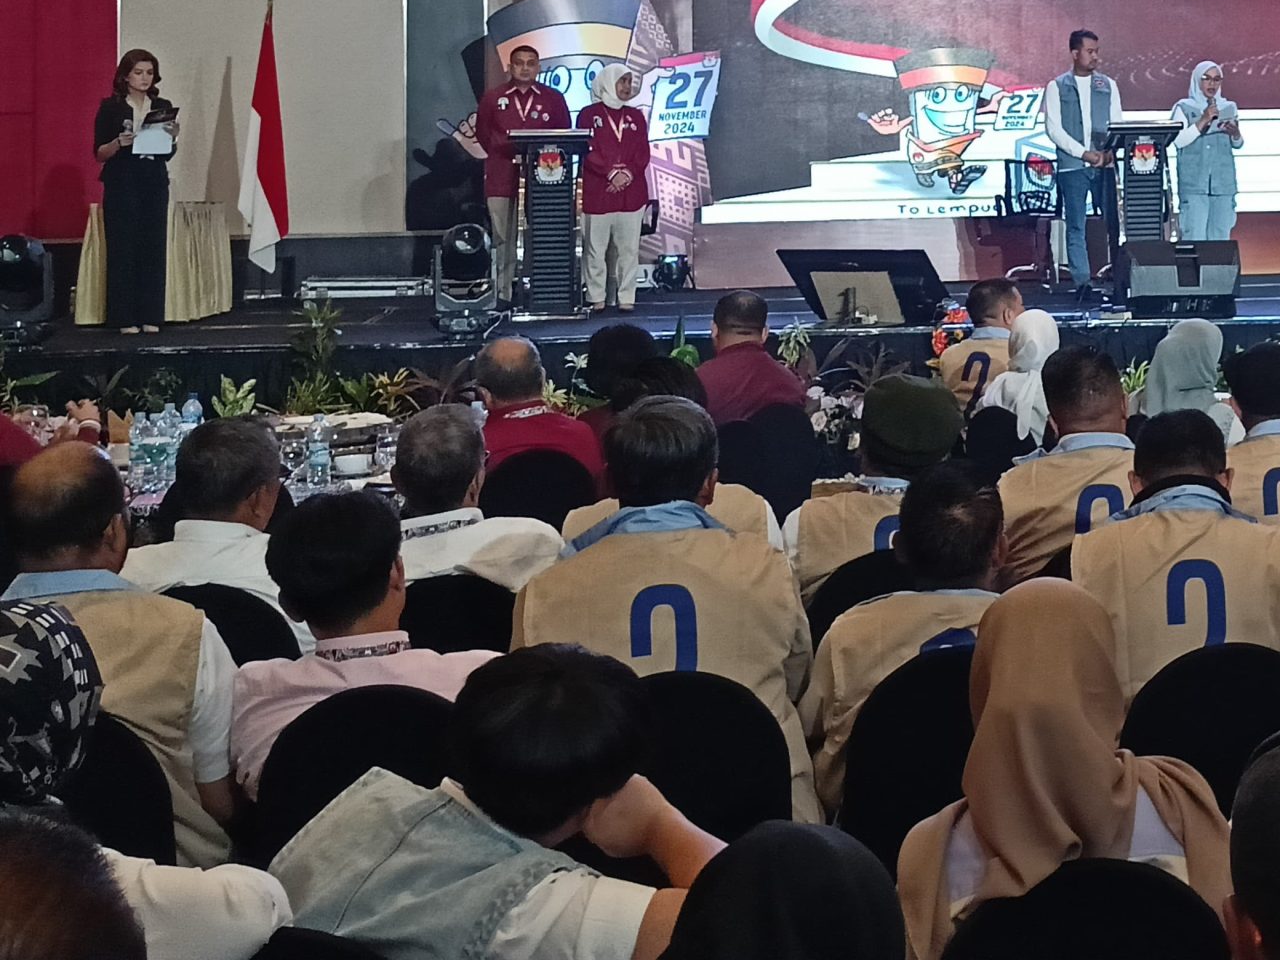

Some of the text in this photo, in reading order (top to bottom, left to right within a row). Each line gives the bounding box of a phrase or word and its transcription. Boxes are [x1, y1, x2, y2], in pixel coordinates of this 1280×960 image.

[665, 70, 714, 109] 27
[1006, 93, 1039, 113] 27
[659, 110, 707, 121] NOVEMBER
[663, 121, 695, 135] 2024
